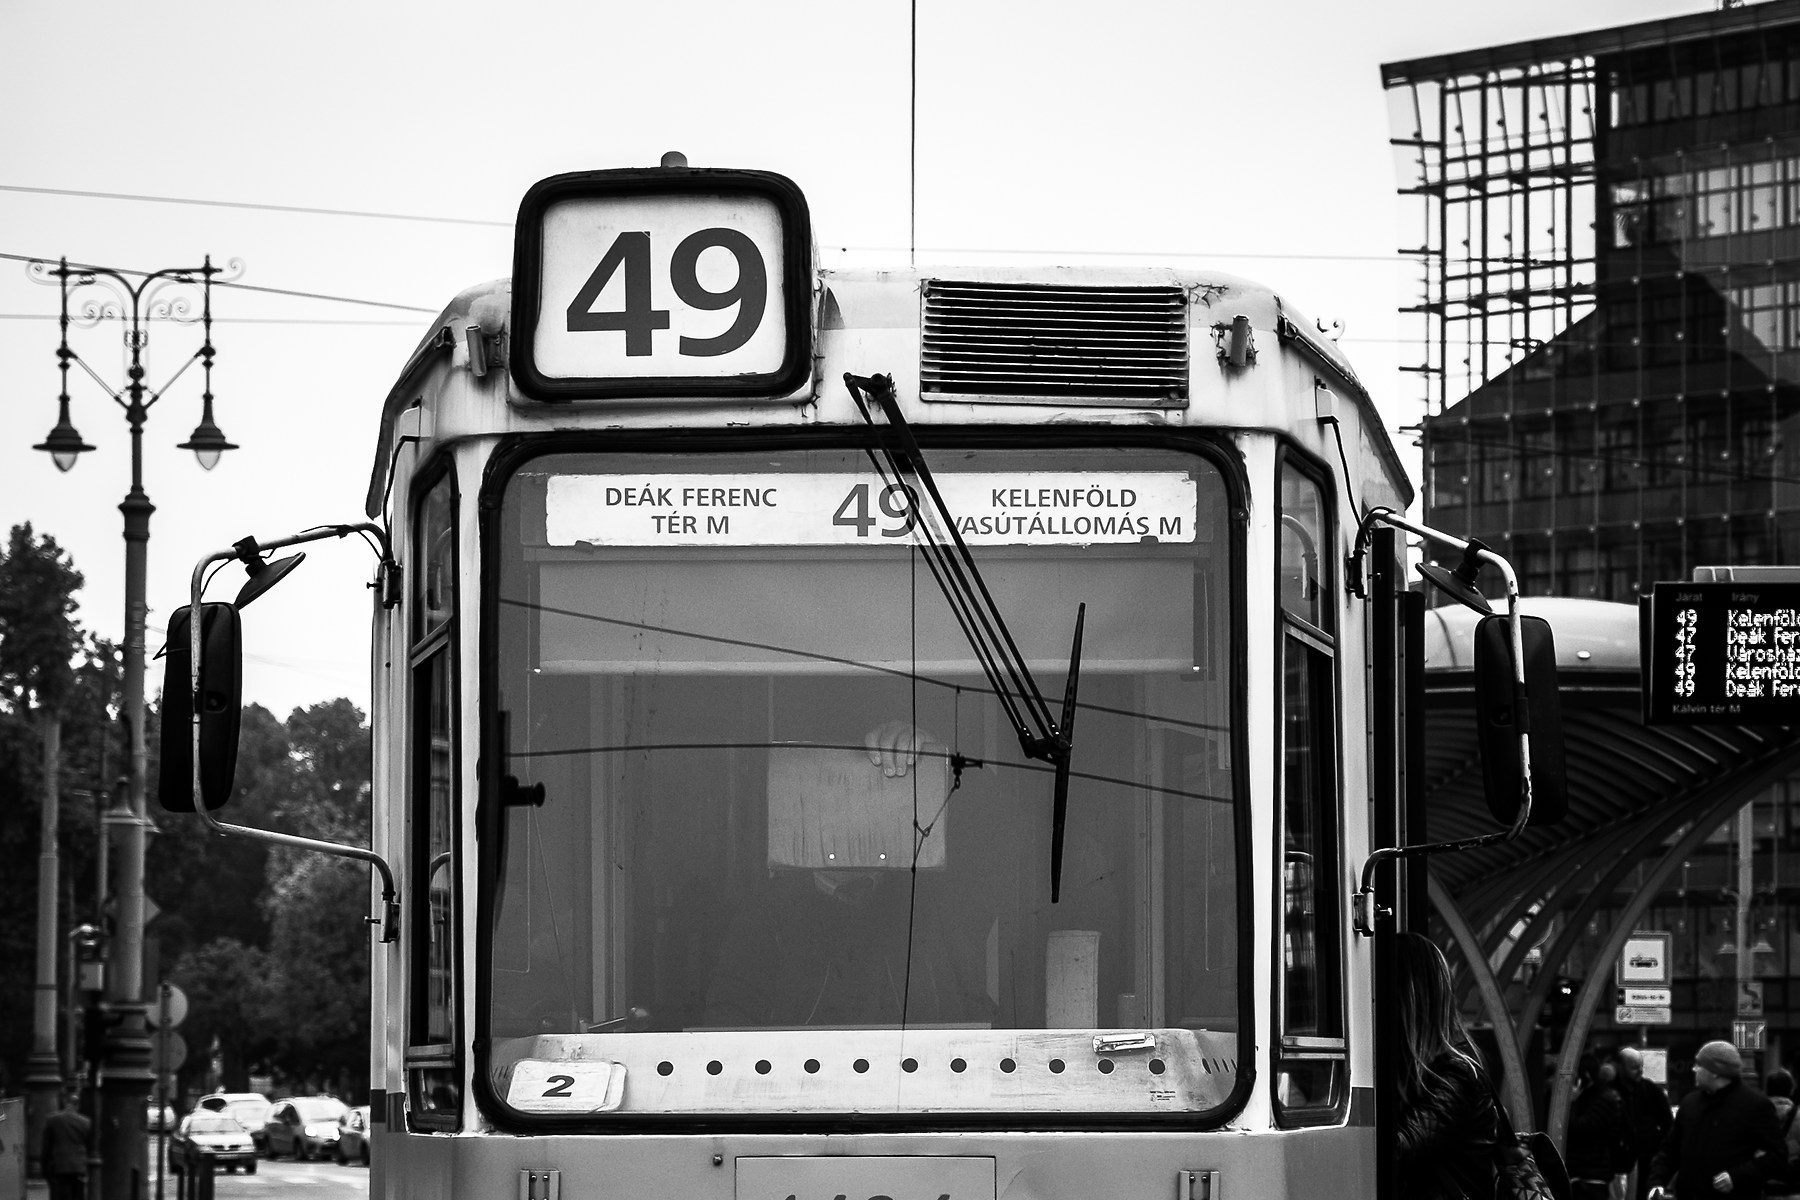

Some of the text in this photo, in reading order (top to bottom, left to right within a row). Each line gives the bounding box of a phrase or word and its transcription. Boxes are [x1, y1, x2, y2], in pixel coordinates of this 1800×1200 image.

[567, 228, 767, 357] 49
[606, 483, 777, 507] DEÁK FERENC
[993, 485, 1137, 507] KELENFÖLD
[833, 484, 920, 537] 49
[651, 511, 729, 534] TÉR M
[1160, 517, 1181, 535] M
[1676, 609, 1698, 626] 49
[1675, 627, 1697, 644] 47
[1727, 627, 1767, 644] Deák
[1675, 645, 1696, 662] 47
[1675, 662, 1696, 679] 49
[1674, 680, 1696, 697] 49
[1726, 680, 1765, 697] Deák
[542, 1075, 575, 1098] 2
